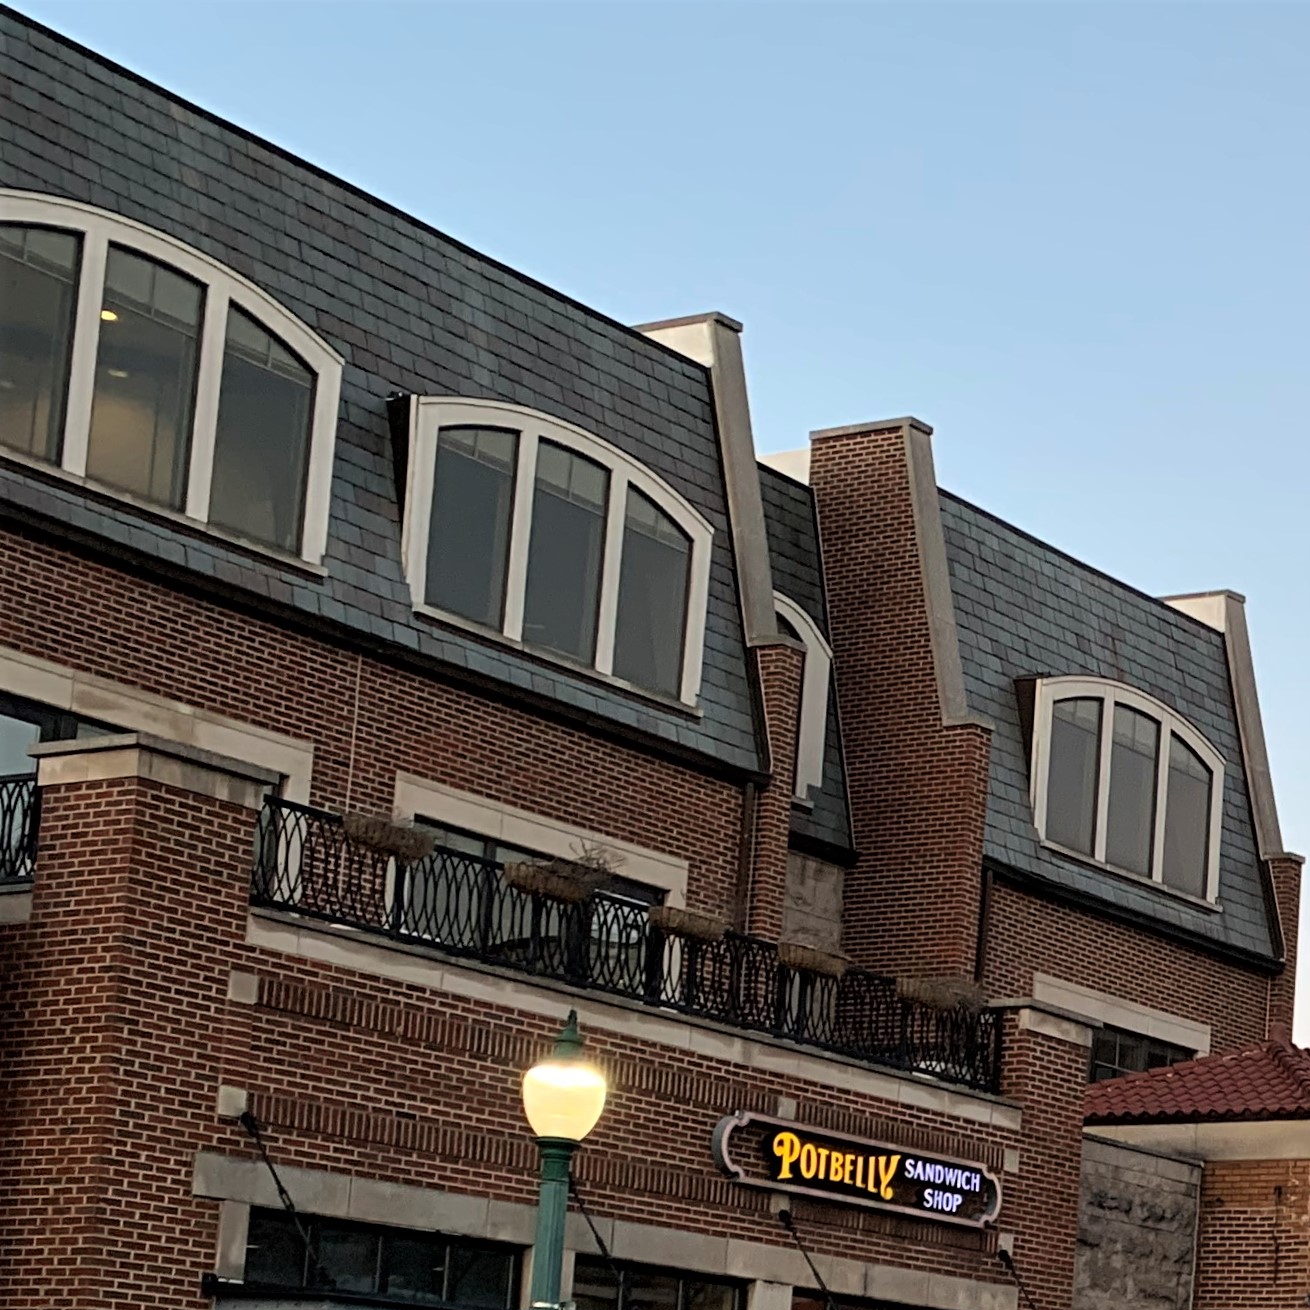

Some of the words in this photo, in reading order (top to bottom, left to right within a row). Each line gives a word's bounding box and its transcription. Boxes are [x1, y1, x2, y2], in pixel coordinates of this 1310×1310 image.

[773, 1132, 901, 1200] POTBELLY
[904, 1158, 981, 1193] SANDWICH
[923, 1188, 962, 1212] SHOP
